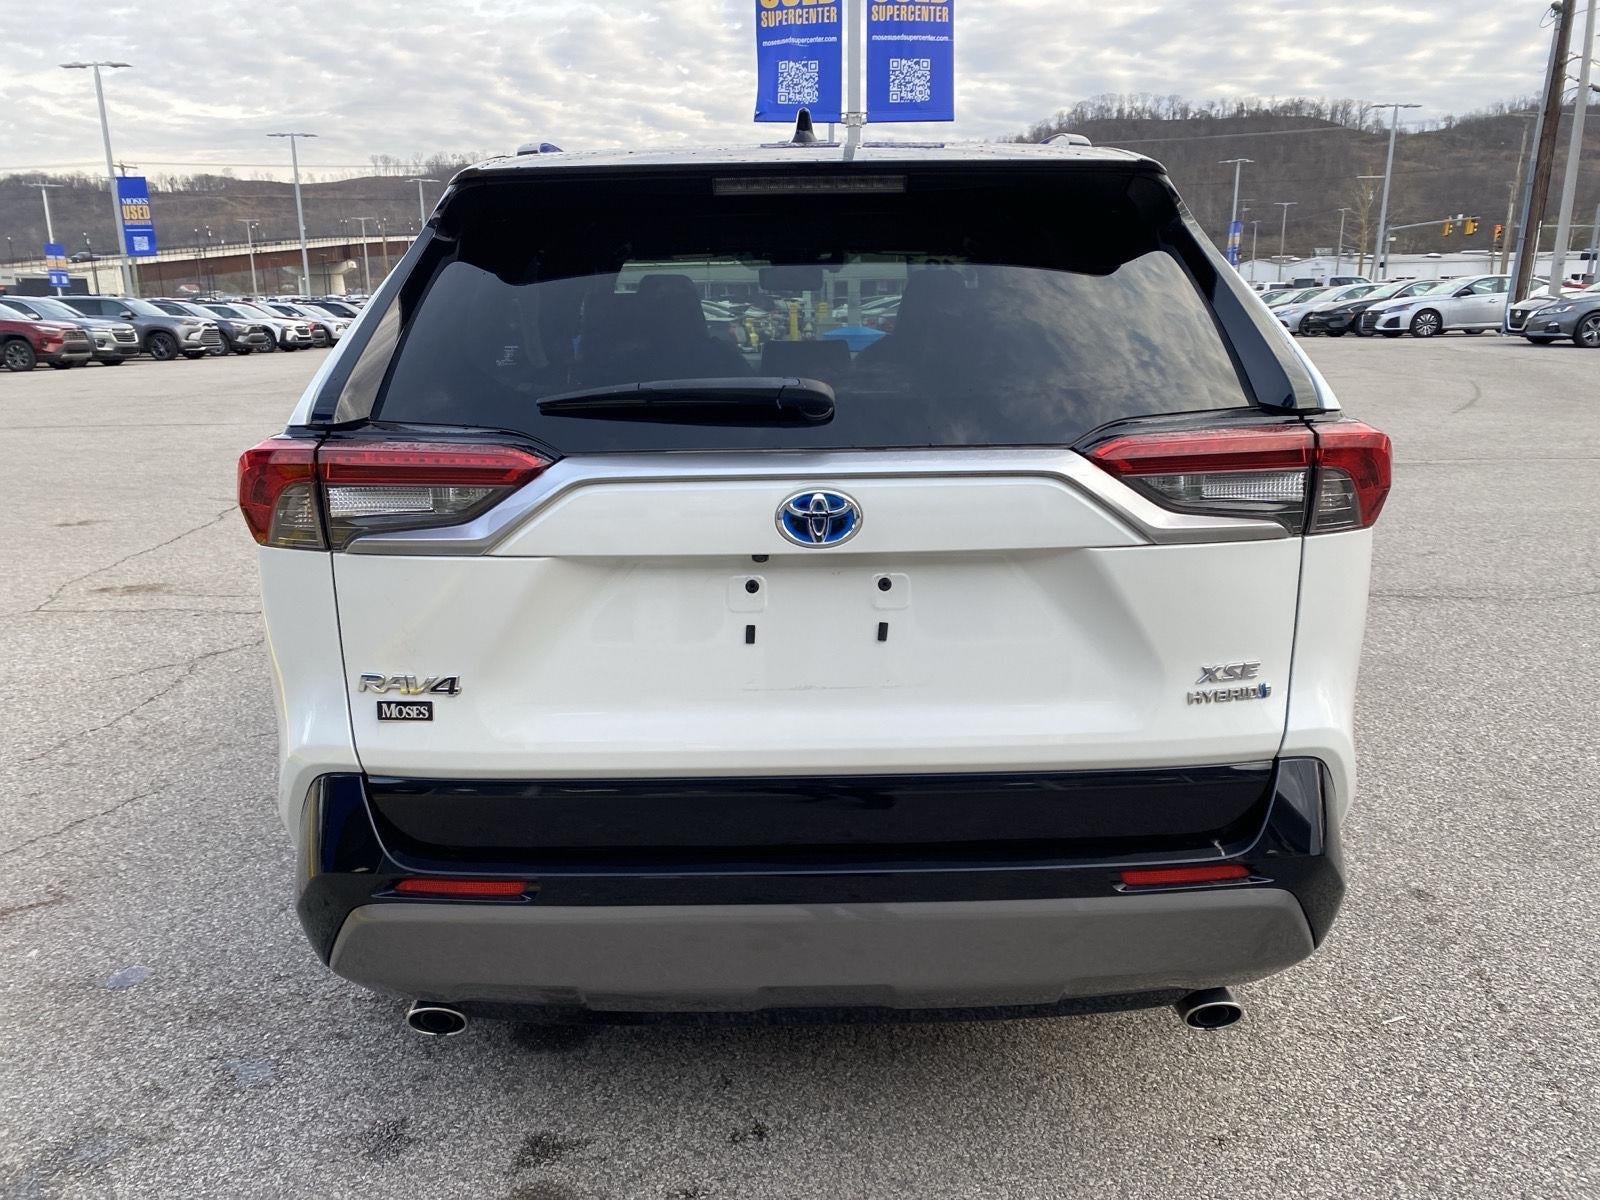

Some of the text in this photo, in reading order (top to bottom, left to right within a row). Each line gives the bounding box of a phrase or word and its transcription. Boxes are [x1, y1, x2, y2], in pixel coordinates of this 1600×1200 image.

[761, 7, 837, 28] SUPERCENTER
[871, 5, 949, 22] SUPERCENTER
[762, 36, 838, 47] mosesusedsupercenter.com
[871, 34, 949, 42] mosesusedsupercenter.com
[122, 205, 151, 220] USED
[1195, 660, 1261, 684] XSE
[359, 672, 461, 697] RAV4
[1187, 686, 1260, 705] HYBRID
